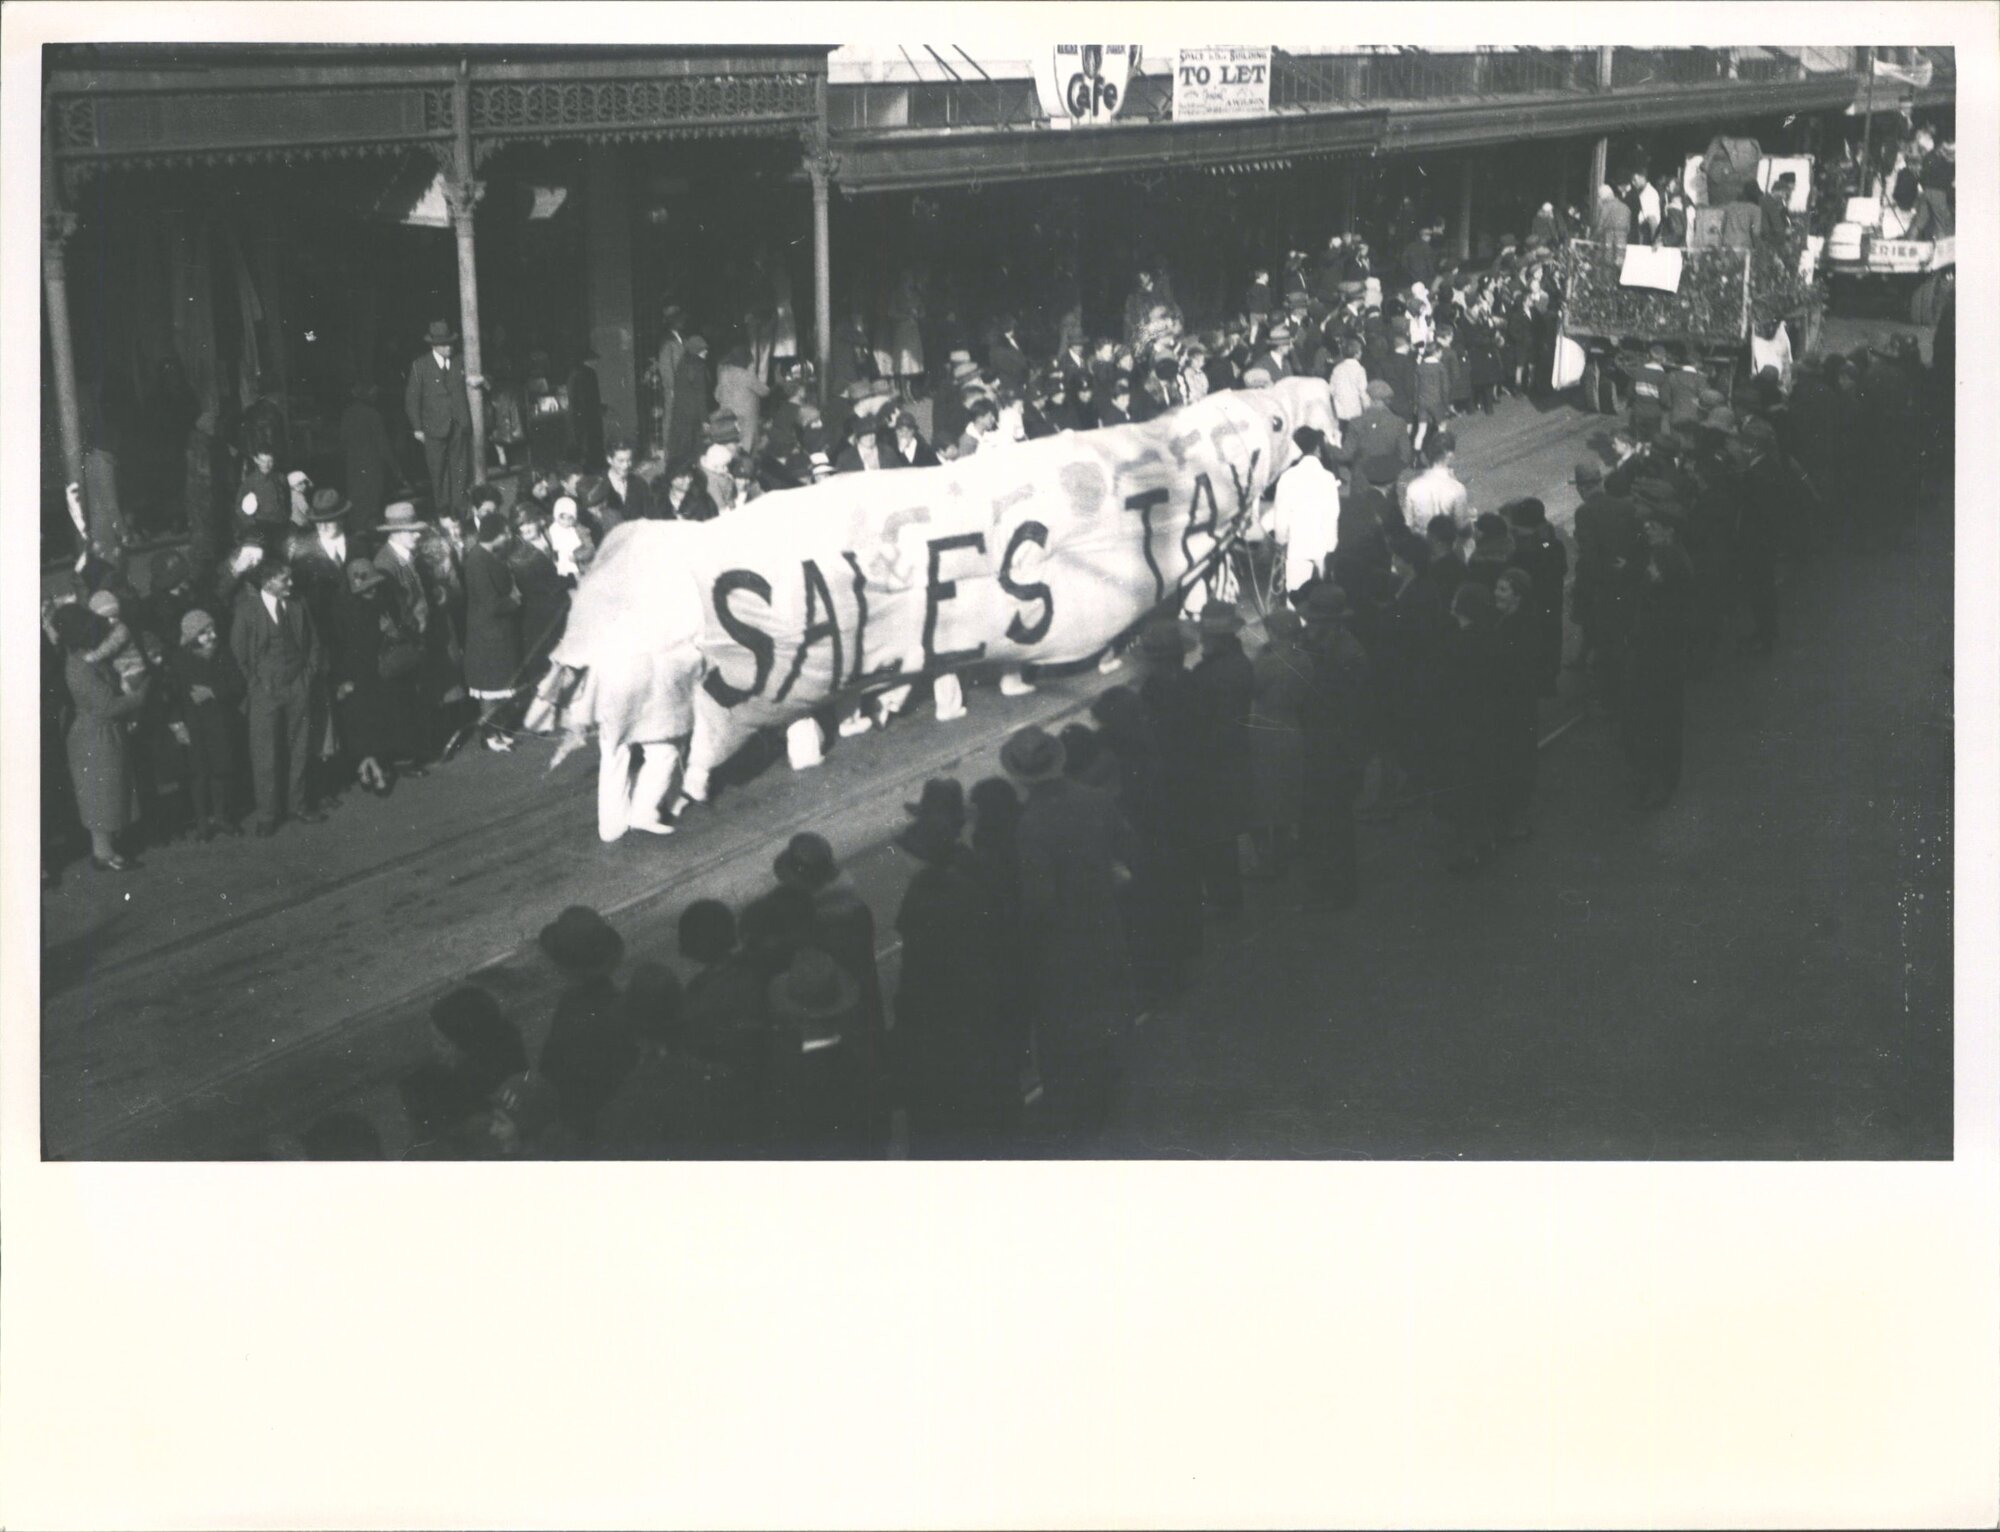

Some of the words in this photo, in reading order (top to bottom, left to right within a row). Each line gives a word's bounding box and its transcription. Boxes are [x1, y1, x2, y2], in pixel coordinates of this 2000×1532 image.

[1179, 65, 1211, 86] TO
[1219, 65, 1266, 85] LET
[702, 520, 1054, 709] SALES
